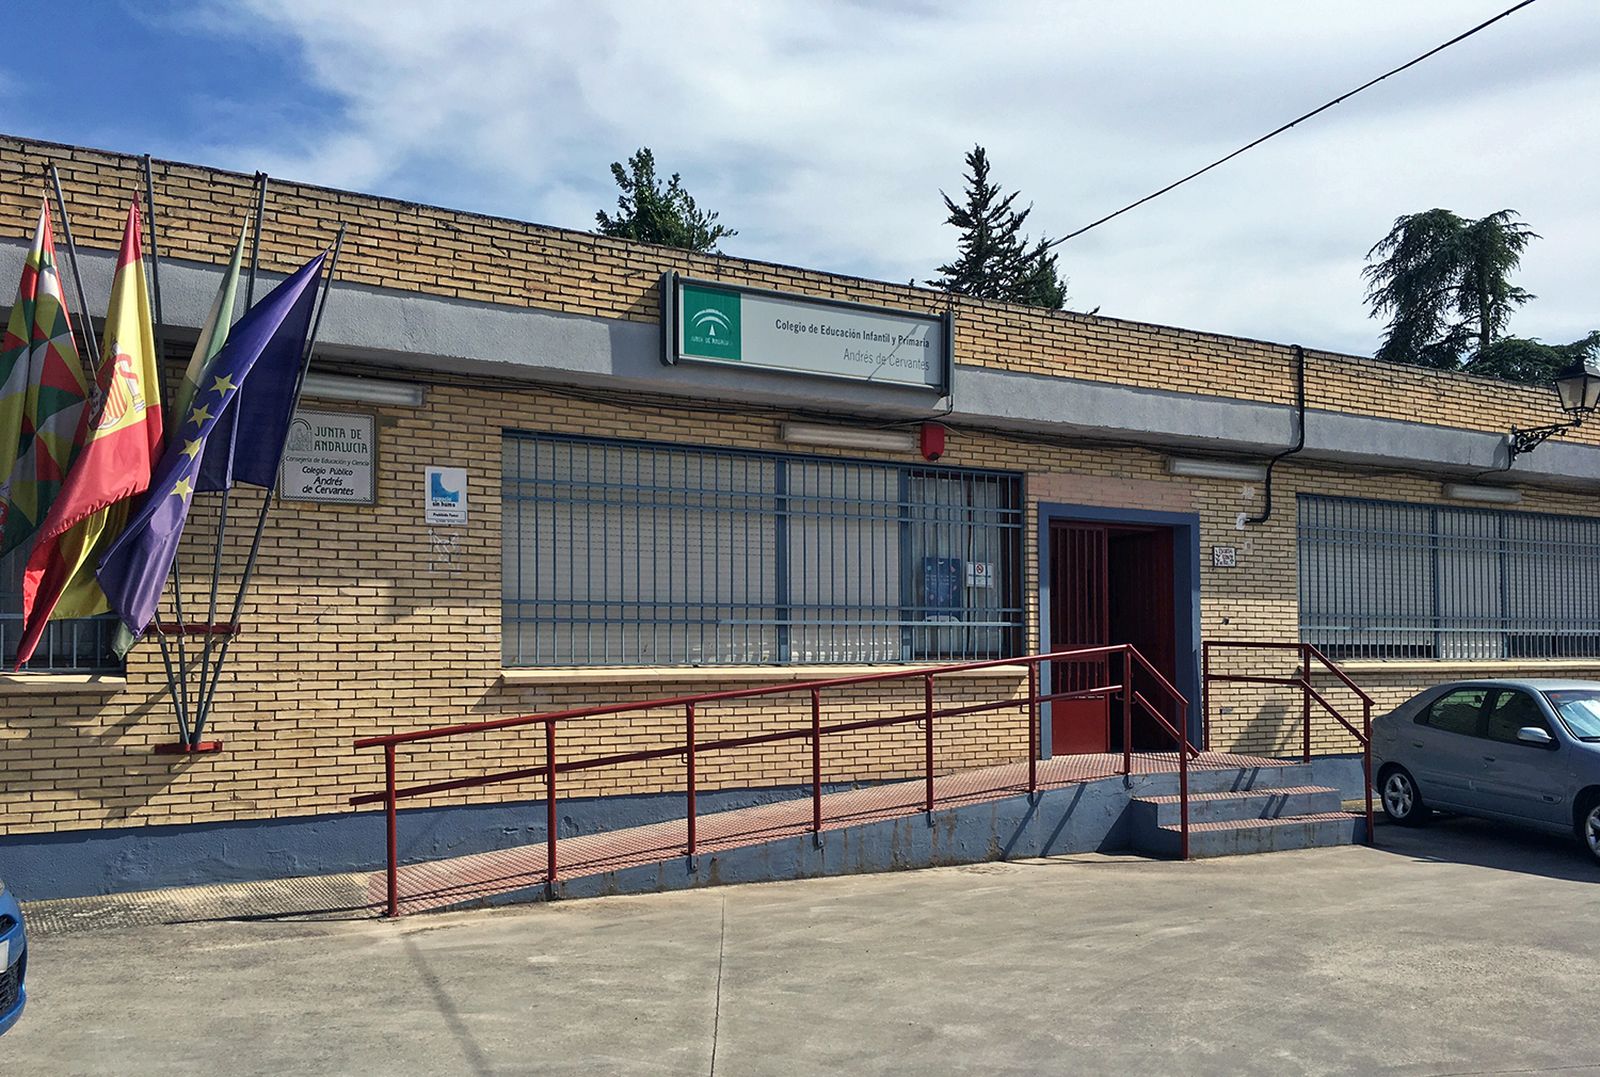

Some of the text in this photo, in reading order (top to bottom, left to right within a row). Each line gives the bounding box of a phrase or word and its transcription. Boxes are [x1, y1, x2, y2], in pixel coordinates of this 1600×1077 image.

[776, 319, 929, 348] Colegio de Educación Infantil y Primaria
[844, 348, 929, 371] Andrés de Cervantes
[314, 426, 361, 439] JUNTA DE
[302, 466, 353, 476] Colegio Público
[313, 477, 343, 486] Andrés
[302, 485, 354, 495] de Cervantes
